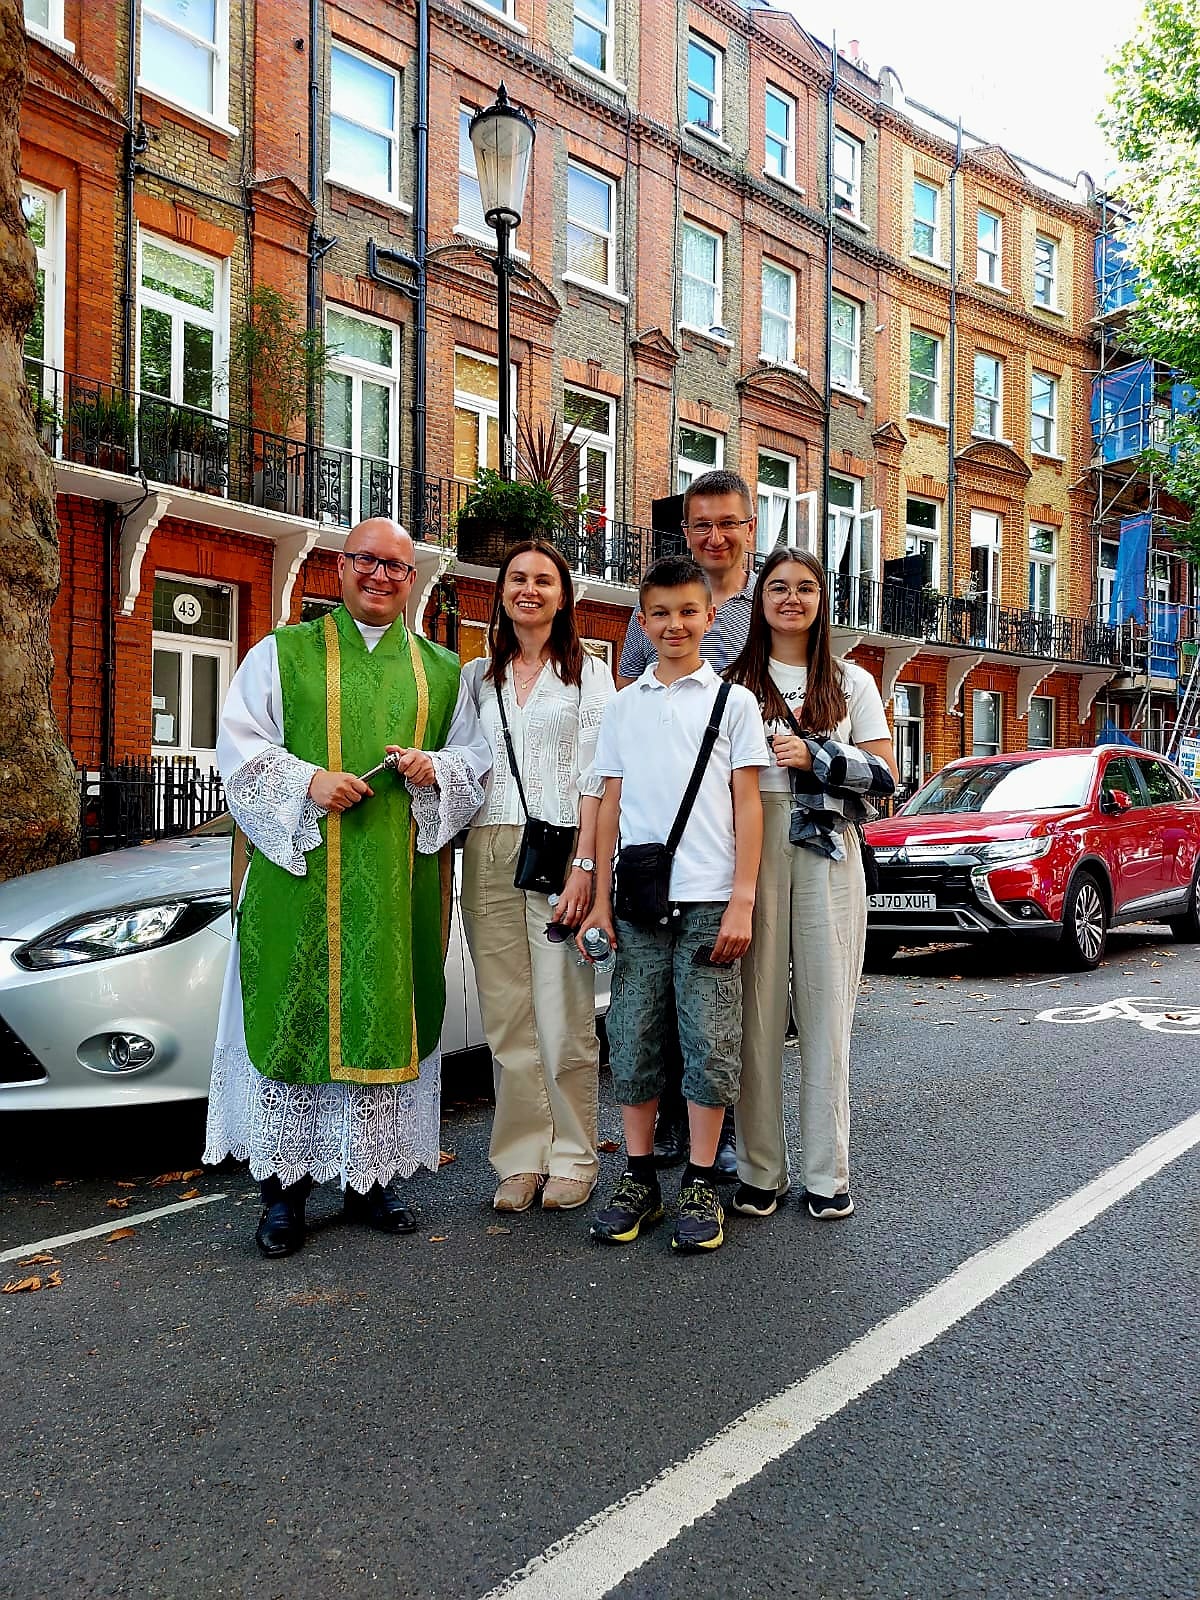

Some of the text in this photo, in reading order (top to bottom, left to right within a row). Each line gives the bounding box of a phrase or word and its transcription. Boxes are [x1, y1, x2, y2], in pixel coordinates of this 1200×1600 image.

[178, 600, 196, 617] 43
[869, 895, 930, 909] SJ70 XUH
